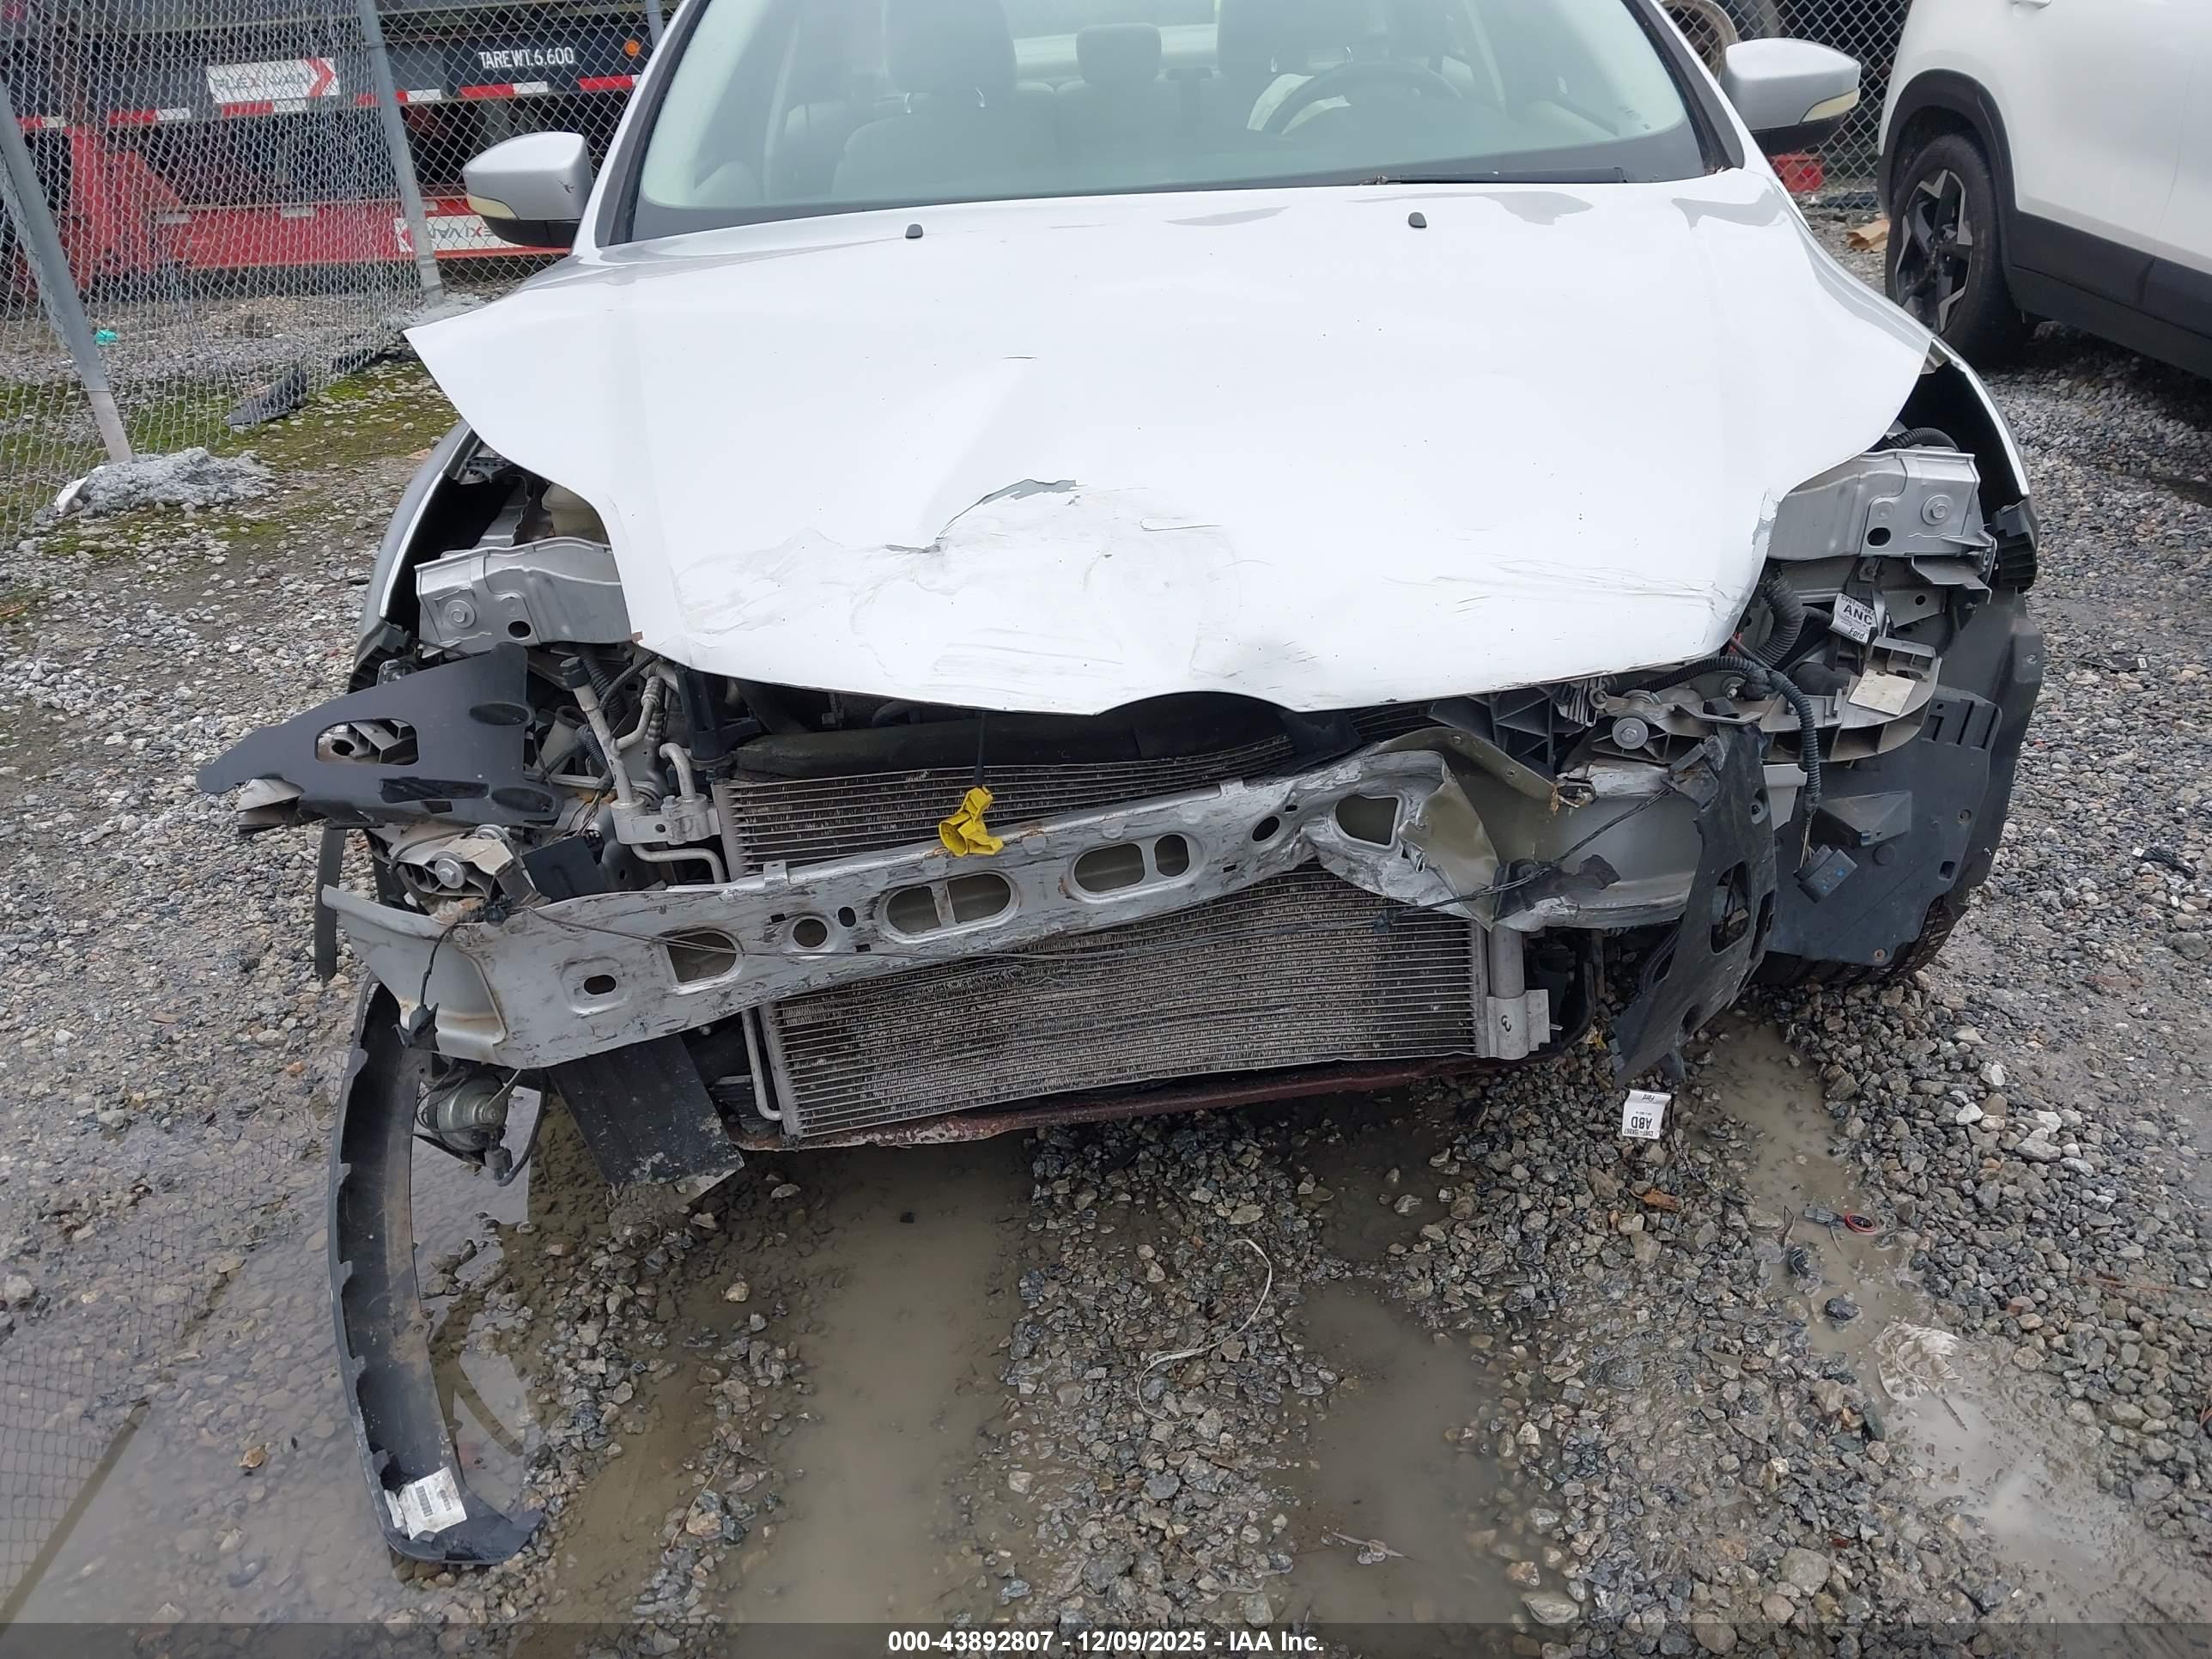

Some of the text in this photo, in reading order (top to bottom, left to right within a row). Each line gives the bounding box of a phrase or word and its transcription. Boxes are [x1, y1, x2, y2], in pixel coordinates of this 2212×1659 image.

[1844, 604, 1873, 625] ANC
[1848, 627, 1866, 640] Ford
[1631, 1116, 1653, 1130] ABD
